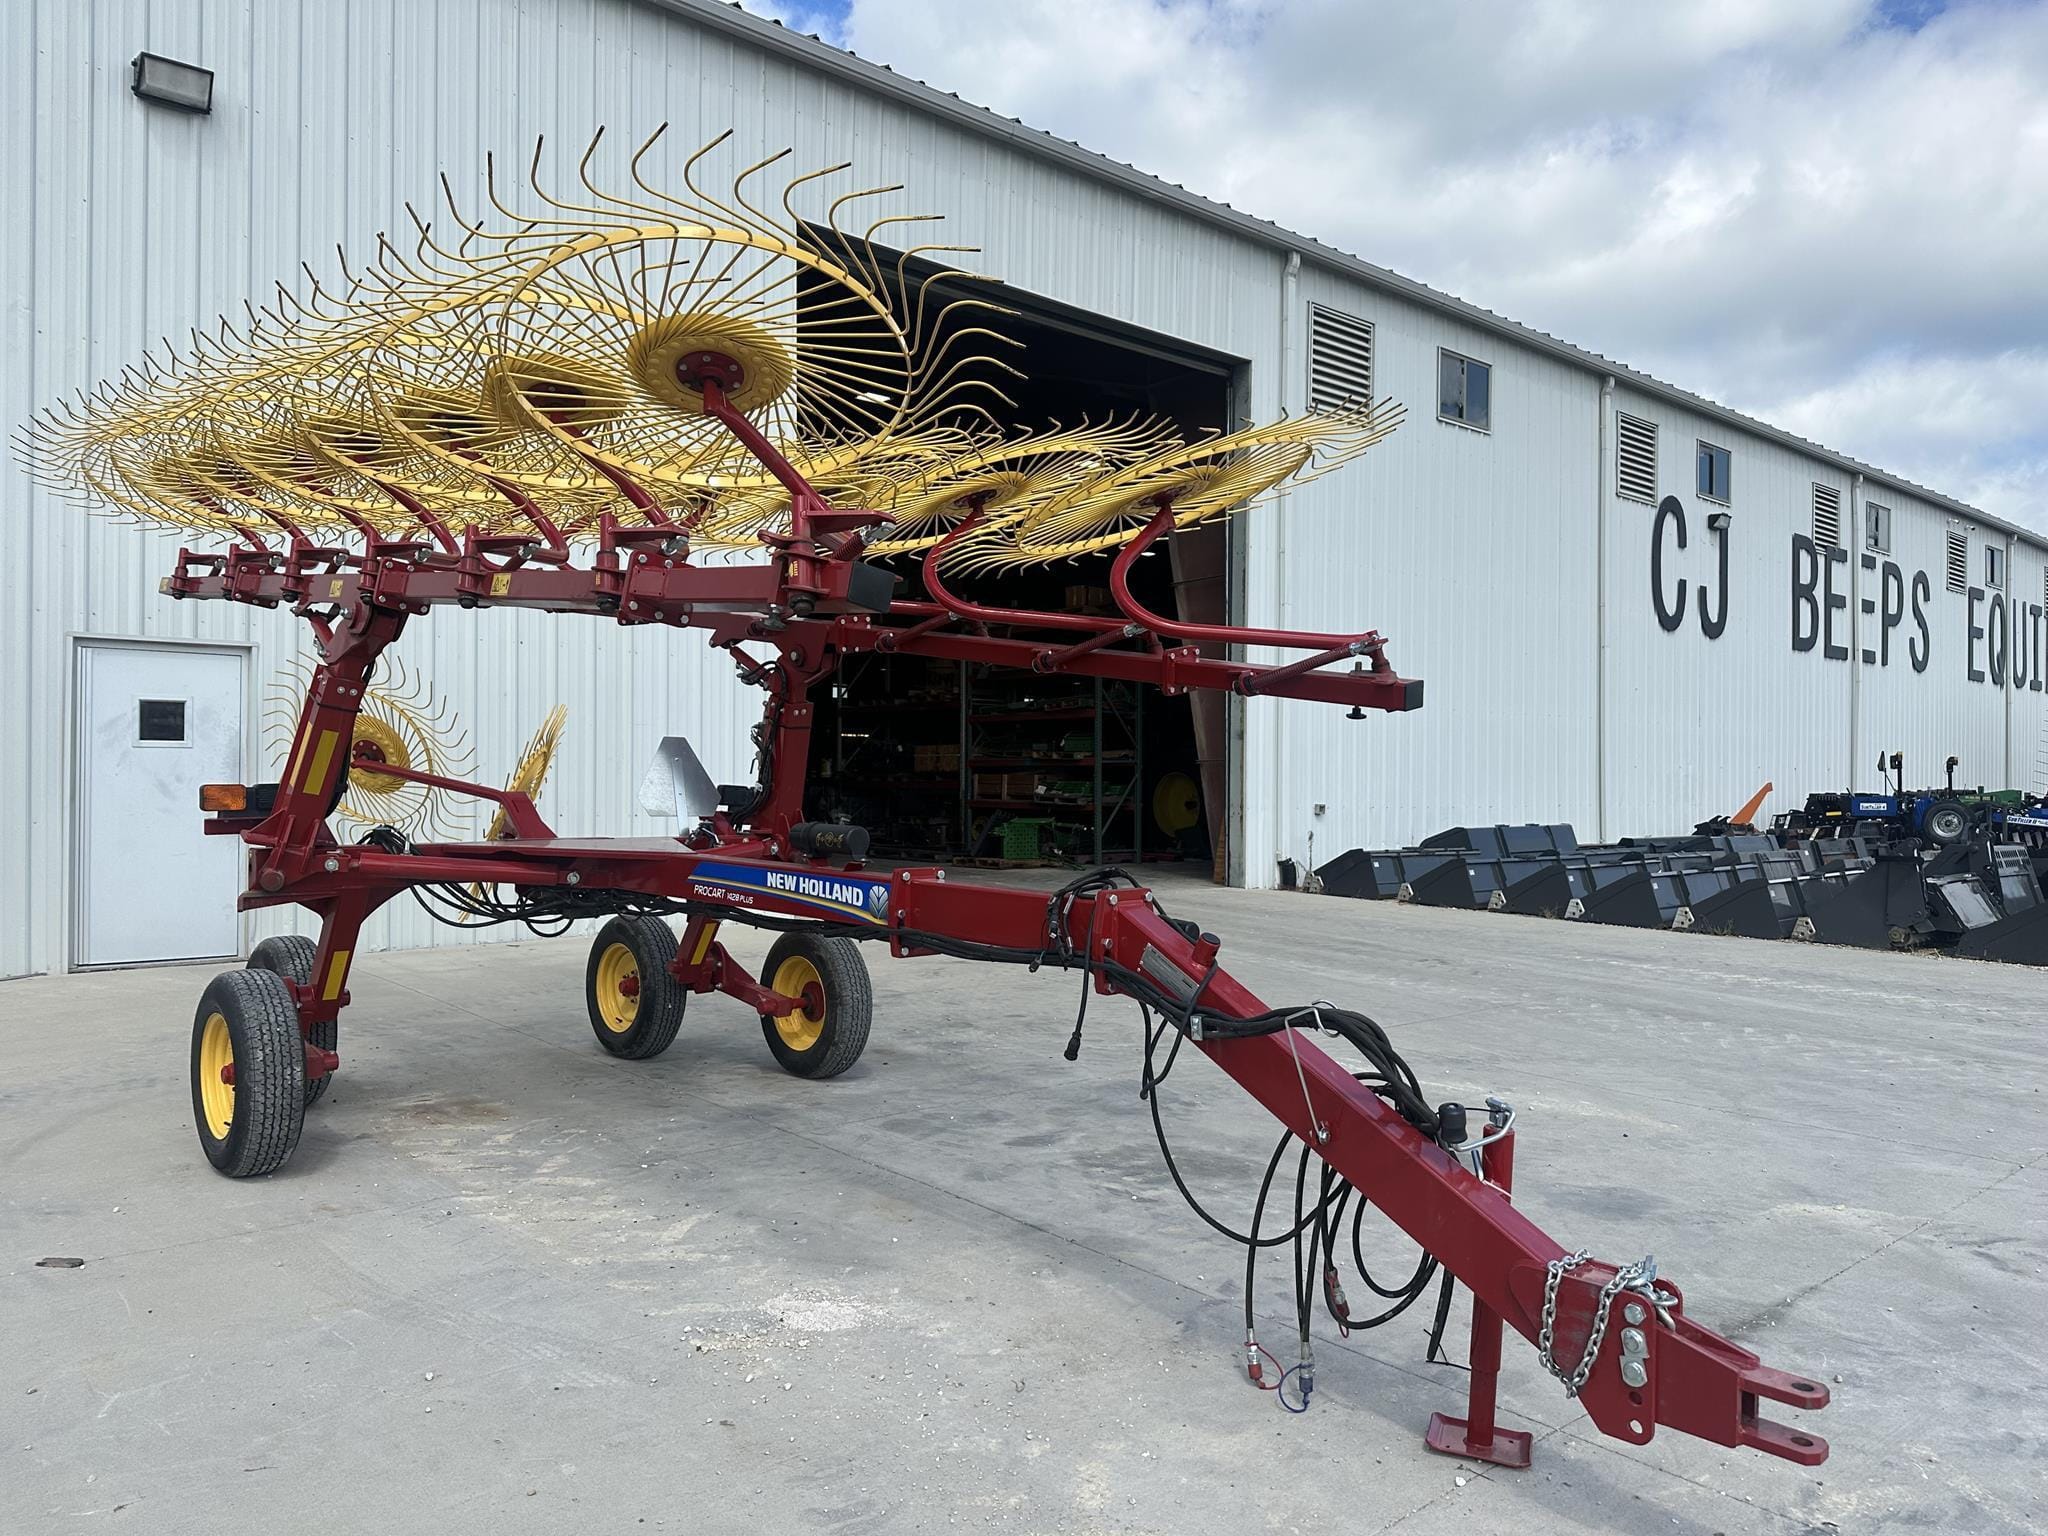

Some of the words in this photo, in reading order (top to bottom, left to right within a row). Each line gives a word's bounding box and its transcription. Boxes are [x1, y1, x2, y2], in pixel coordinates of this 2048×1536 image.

[1652, 495, 1729, 639] CJ
[1792, 533, 1930, 673] BEEPS
[1968, 586, 2048, 693] EQUI
[693, 884, 726, 899] PROCART
[739, 894, 754, 904] PLUS
[767, 871, 797, 892] NEW
[799, 876, 864, 907] HOLLAND
